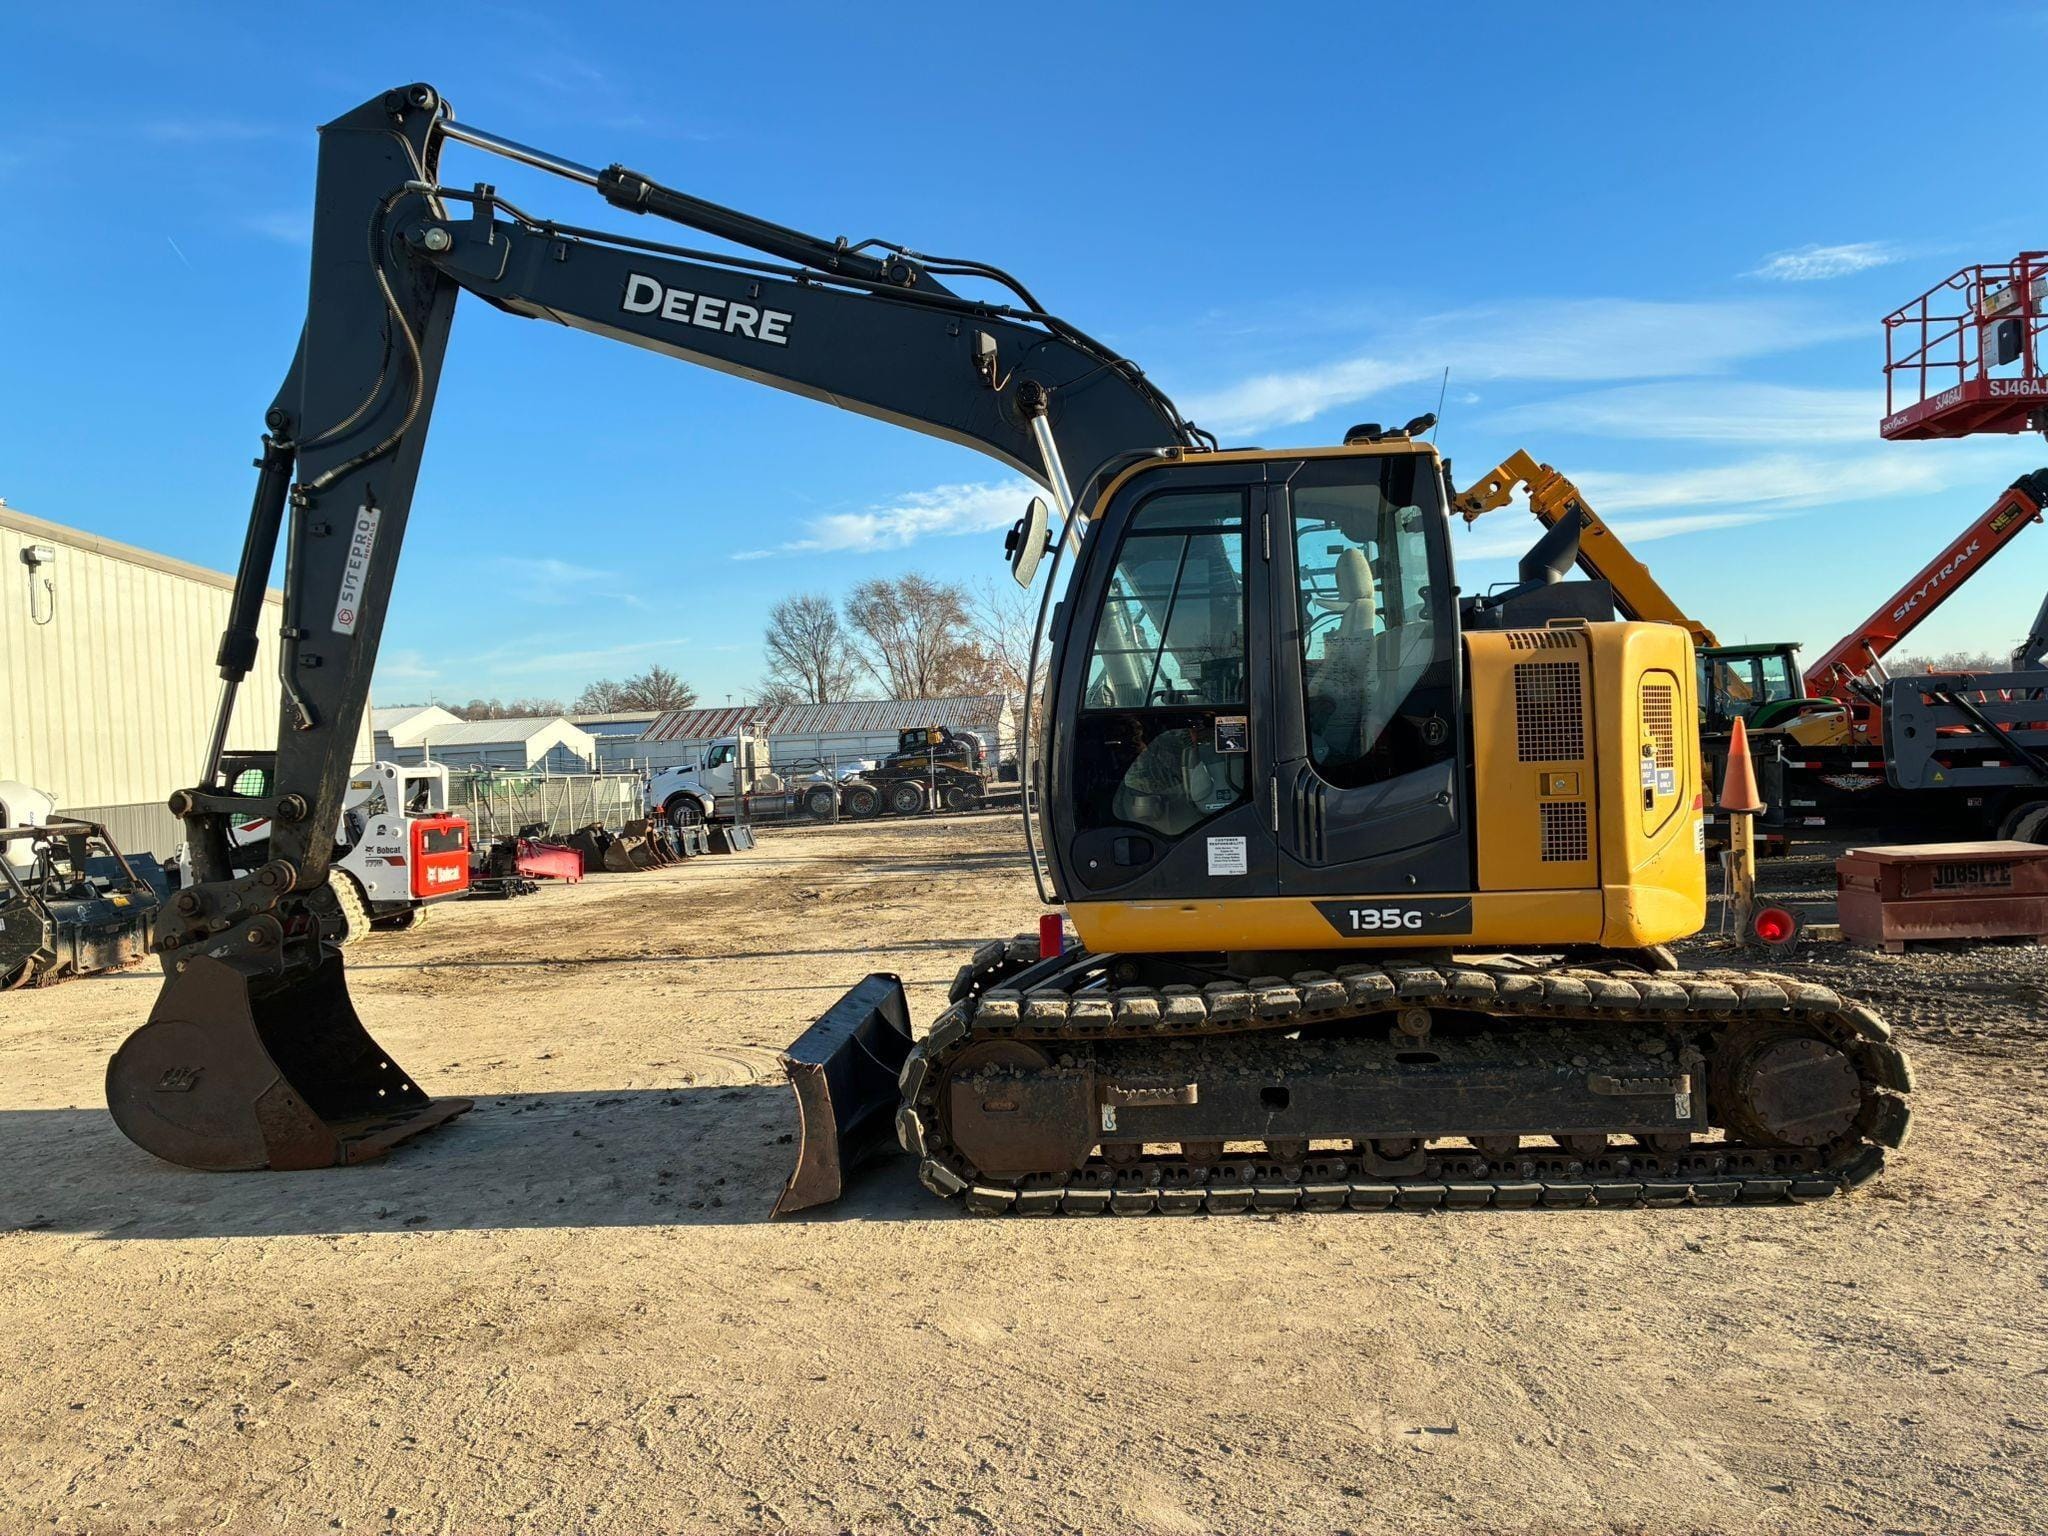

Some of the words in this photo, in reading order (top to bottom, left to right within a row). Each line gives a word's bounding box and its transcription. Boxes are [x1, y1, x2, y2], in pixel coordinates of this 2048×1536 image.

[622, 273, 793, 345] DEERE
[341, 519, 370, 603] SITEPRO
[1893, 538, 1980, 622] SKYTRAK
[376, 846, 401, 855] Bobcat
[1933, 862, 2012, 885] JOBSITE
[1349, 908, 1423, 930] 135G
